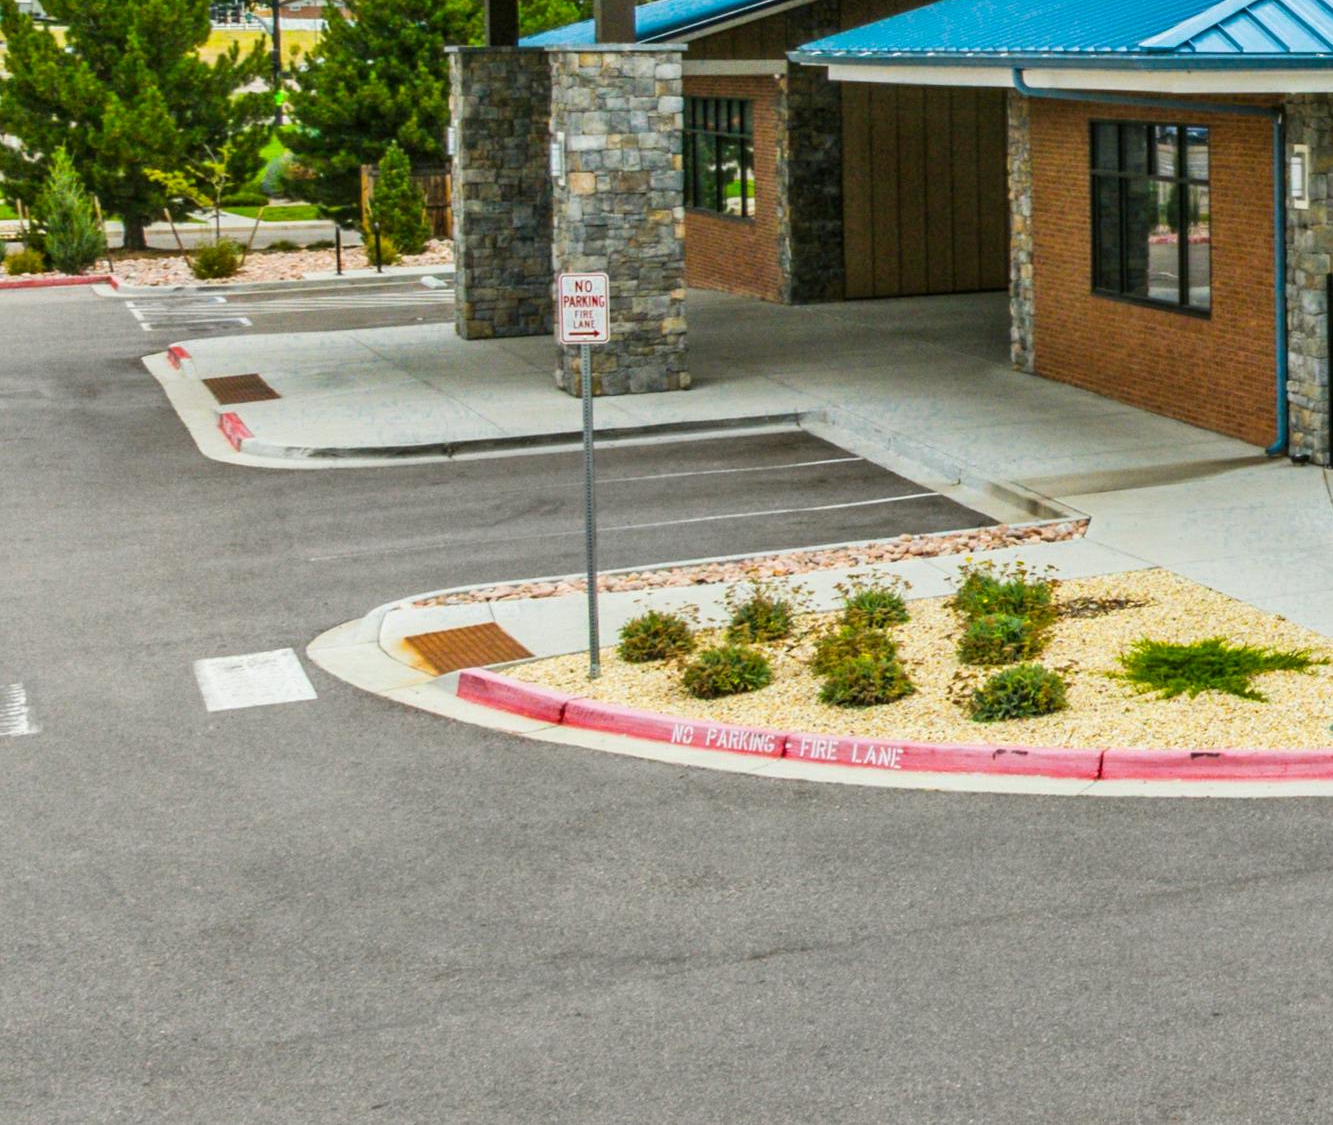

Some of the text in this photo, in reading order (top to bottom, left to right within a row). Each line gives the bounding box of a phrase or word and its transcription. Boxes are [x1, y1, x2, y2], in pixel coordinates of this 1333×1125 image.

[575, 280, 593, 293] NO
[563, 295, 605, 308] PARKING
[574, 309, 594, 319] FIRE
[573, 319, 596, 329] LANE
[671, 723, 694, 744] NO
[705, 726, 776, 753] PARKING
[800, 735, 839, 761] FIRE
[851, 742, 904, 769] LANE
